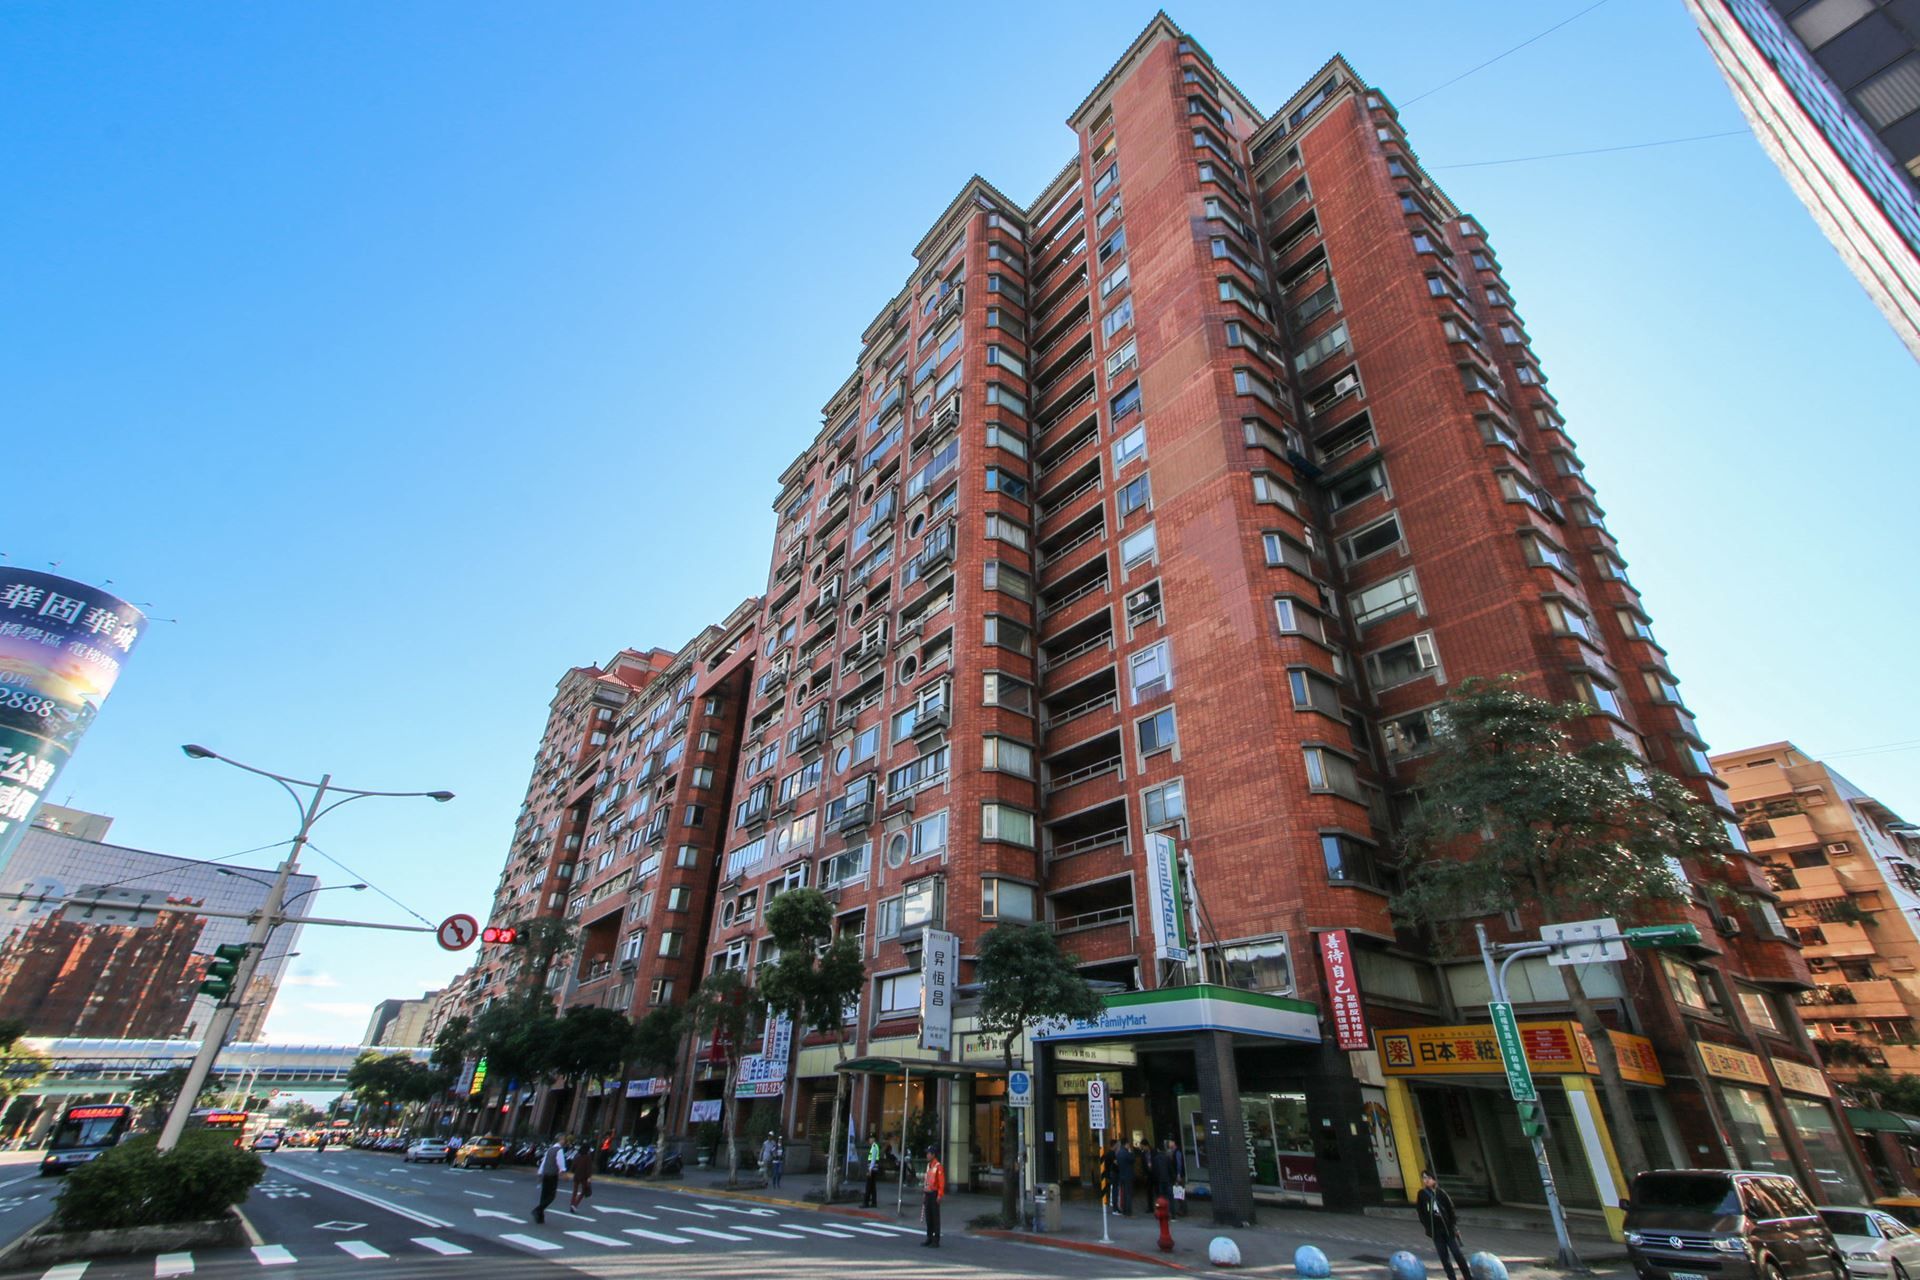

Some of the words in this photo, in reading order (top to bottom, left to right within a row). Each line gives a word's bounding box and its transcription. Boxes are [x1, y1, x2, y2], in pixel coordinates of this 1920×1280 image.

[1158, 842, 1176, 939] FamilyMart
[932, 950, 945, 1007] 昇恆昌
[1326, 933, 1351, 994] 善待自己
[1100, 1013, 1147, 1031] FamilyMart
